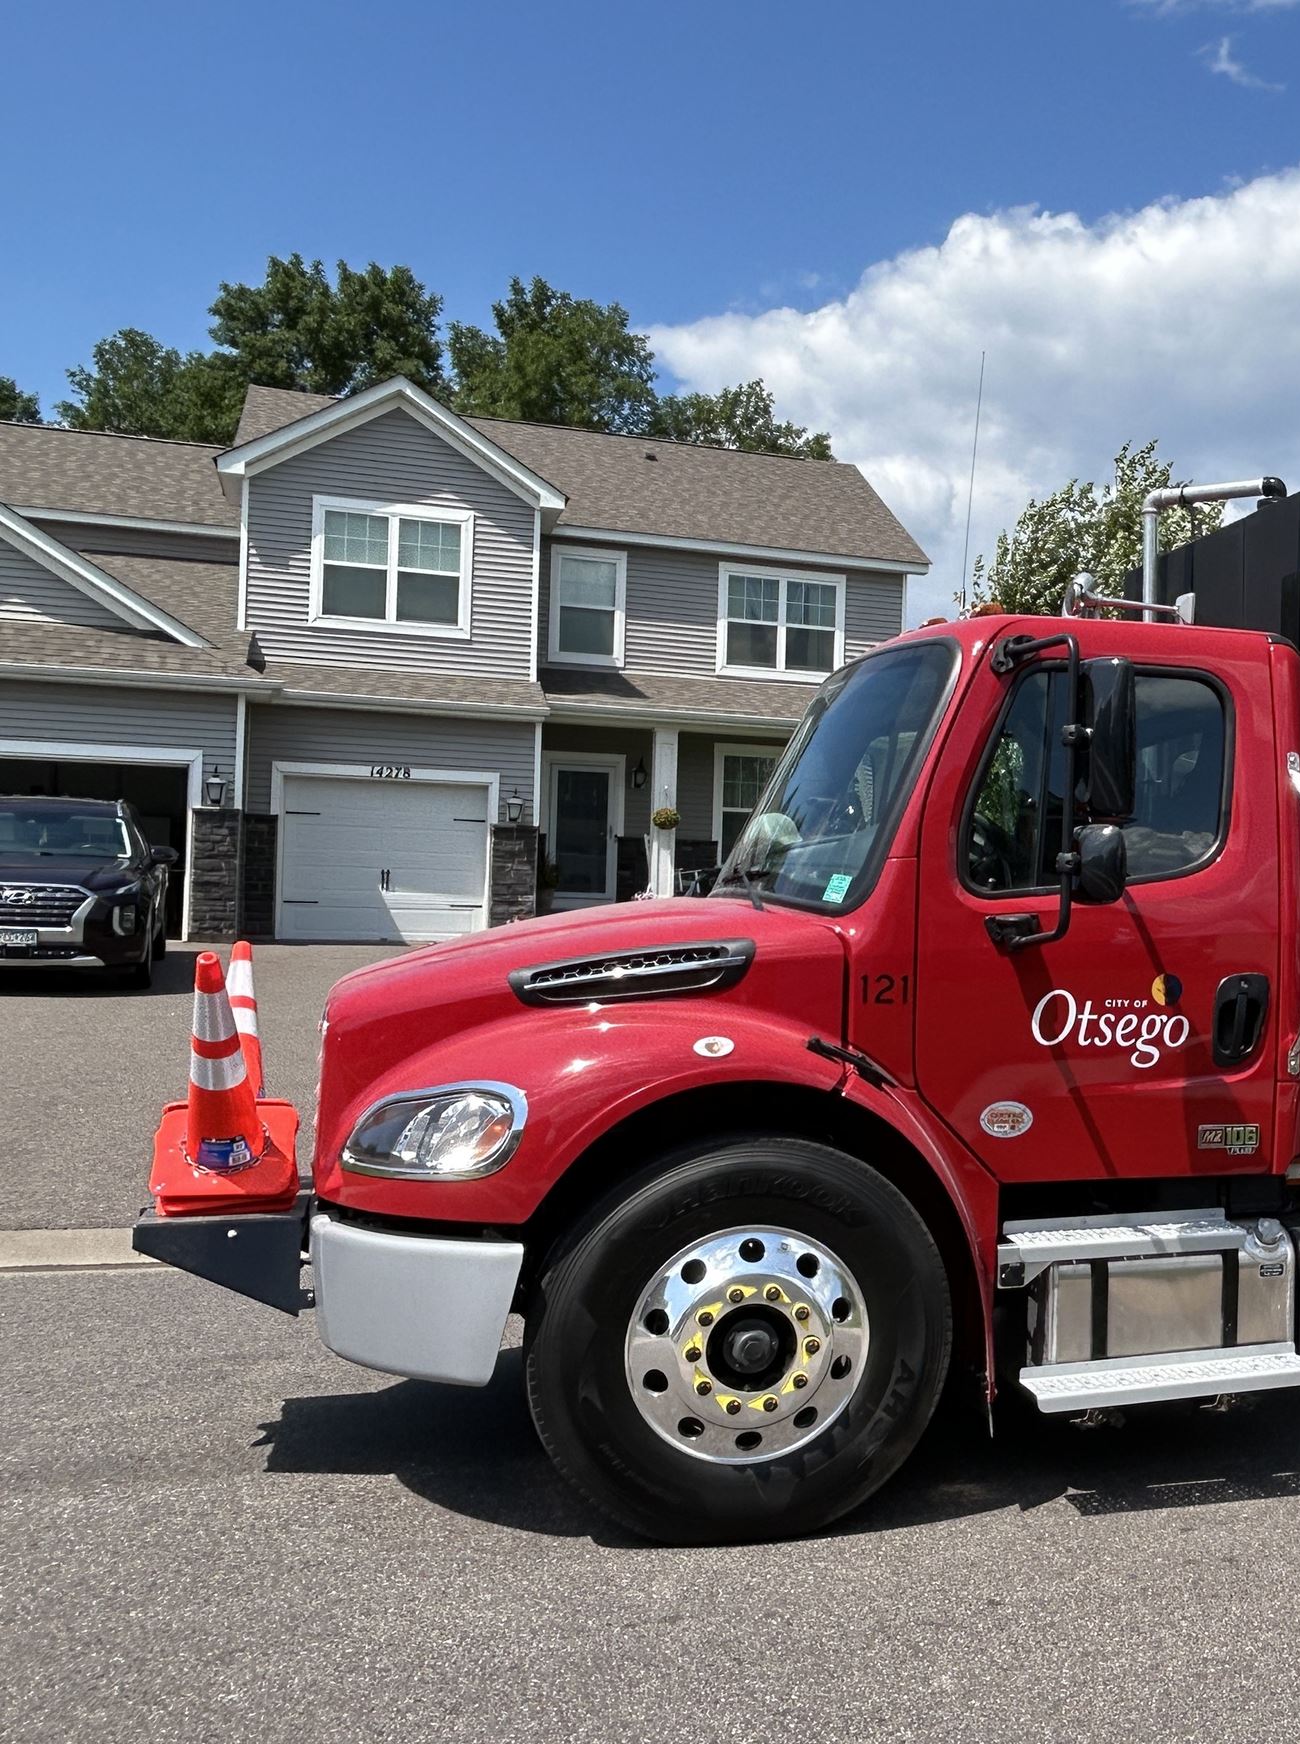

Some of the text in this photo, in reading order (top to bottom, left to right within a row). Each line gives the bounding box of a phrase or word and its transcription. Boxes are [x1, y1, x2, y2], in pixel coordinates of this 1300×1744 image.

[370, 766, 411, 778] 14278
[860, 973, 910, 1006] 121
[1104, 999, 1148, 1008] CITY OF
[1031, 989, 1190, 1068] Otsego
[1226, 1126, 1257, 1145] 106
